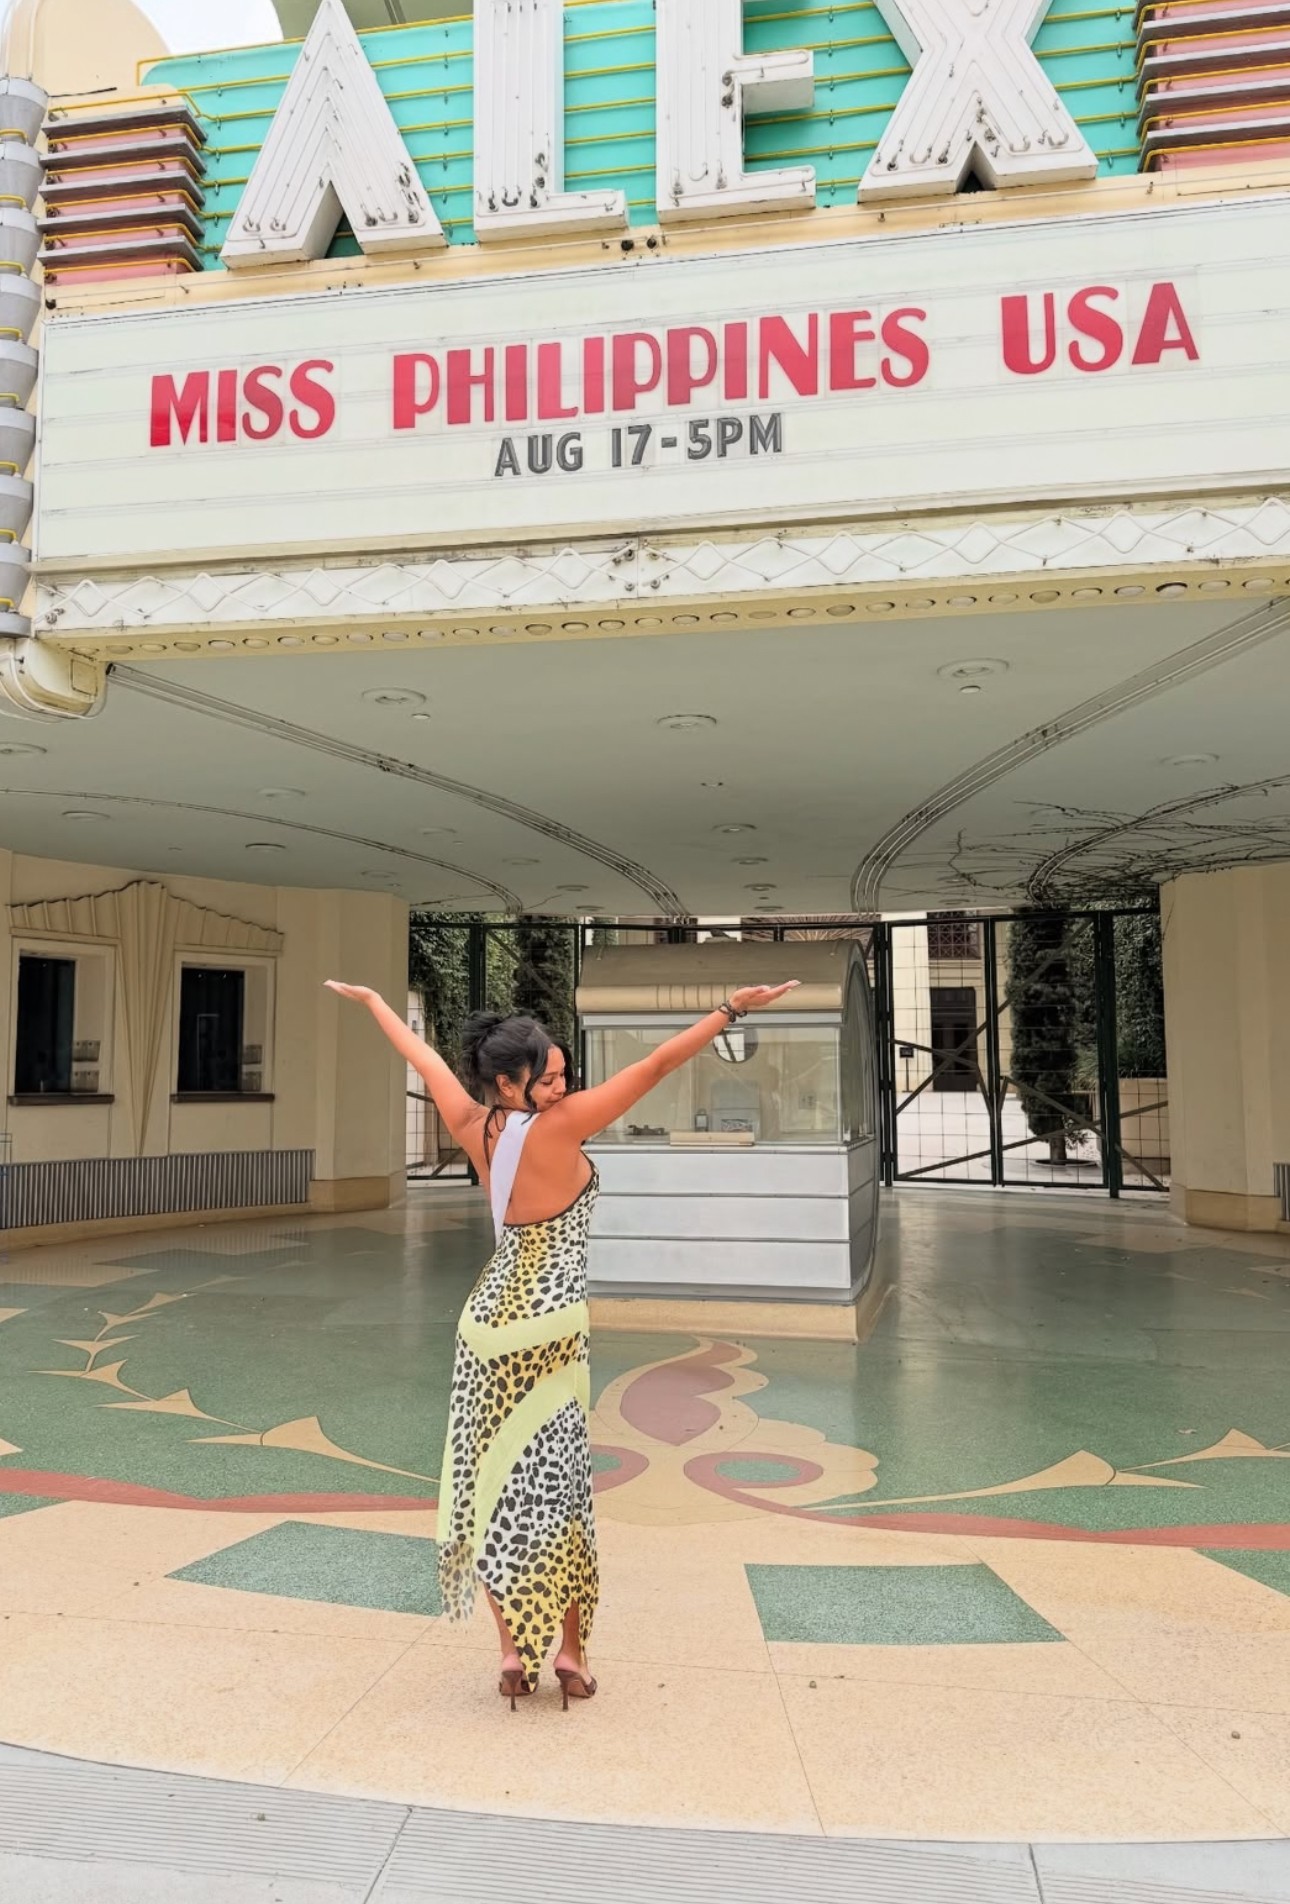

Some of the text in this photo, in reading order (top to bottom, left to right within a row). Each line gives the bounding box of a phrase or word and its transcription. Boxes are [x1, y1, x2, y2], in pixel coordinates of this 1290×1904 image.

[220, 0, 1098, 269] ALEX
[149, 282, 1199, 447] MISS PHILIPPINES USA
[494, 432, 584, 477] AUG
